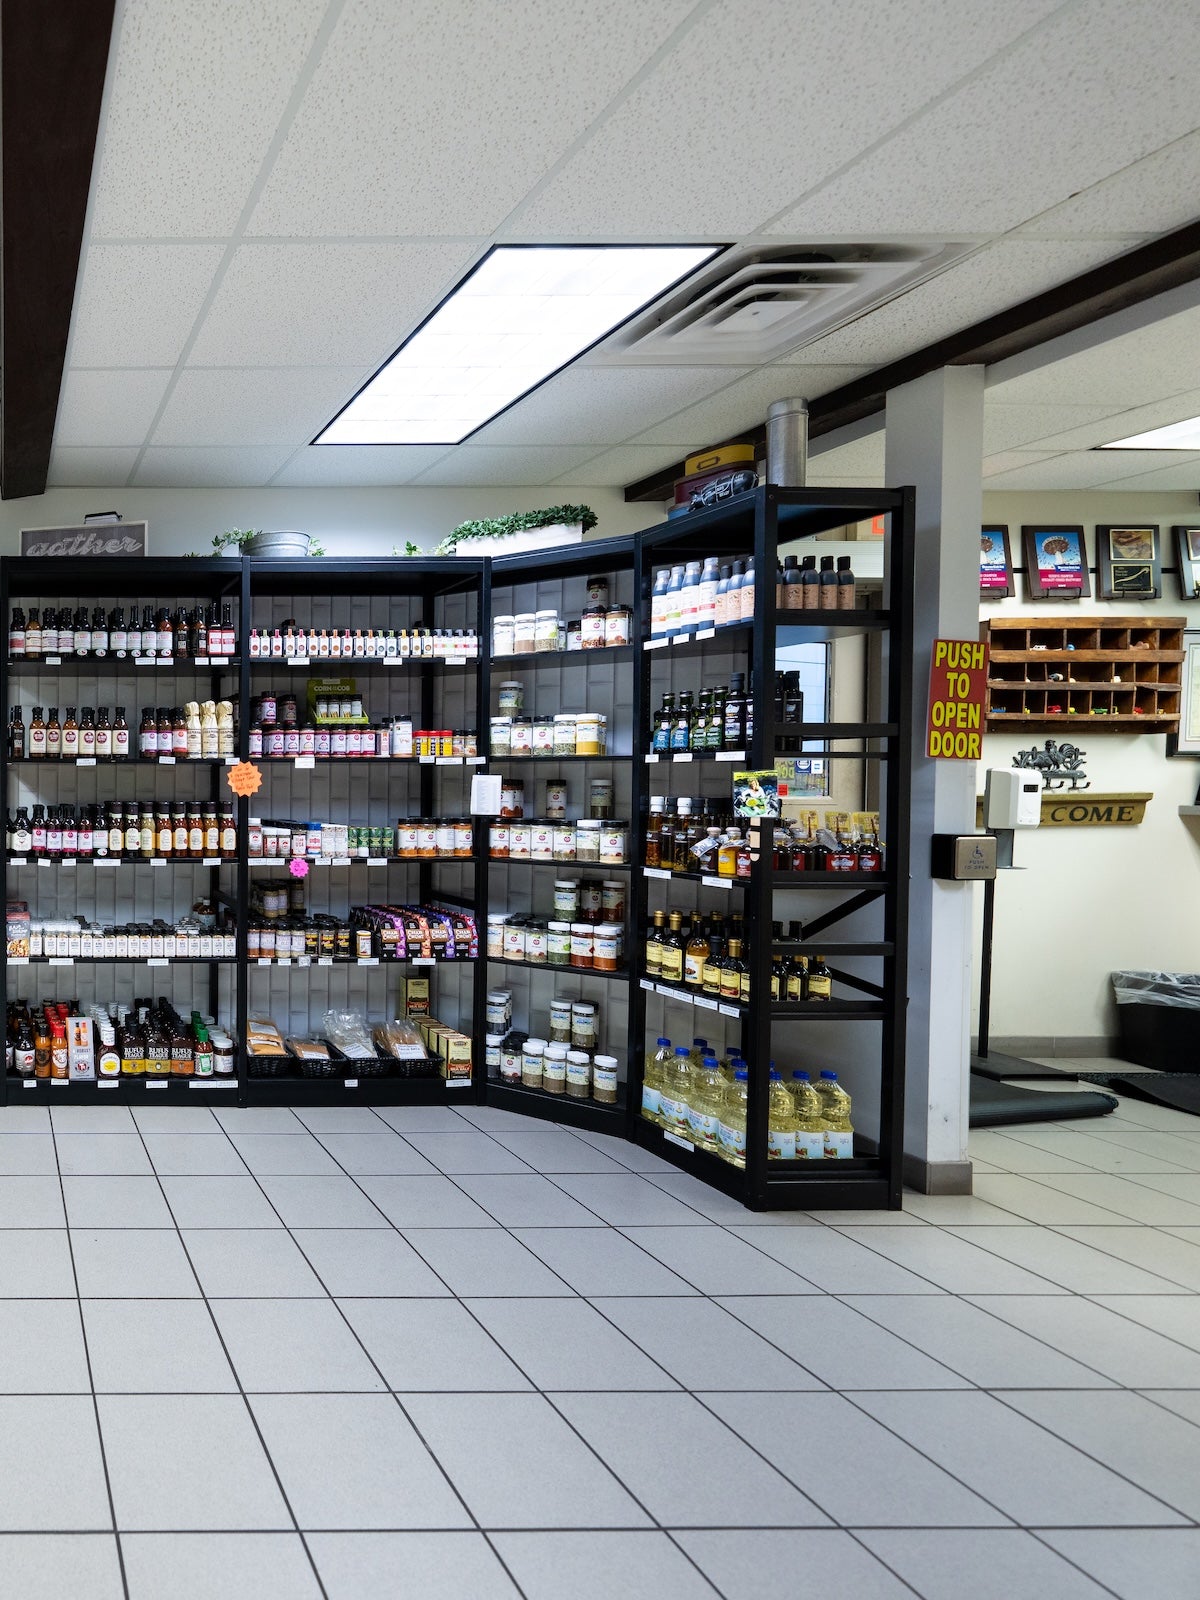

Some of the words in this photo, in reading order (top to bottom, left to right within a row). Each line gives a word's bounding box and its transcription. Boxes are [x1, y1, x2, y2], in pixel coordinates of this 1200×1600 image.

[935, 641, 985, 670] PUSH
[946, 672, 970, 699] TO
[932, 701, 981, 729] OPEN
[929, 731, 980, 759] DOOR
[1040, 806, 1134, 823] COME
